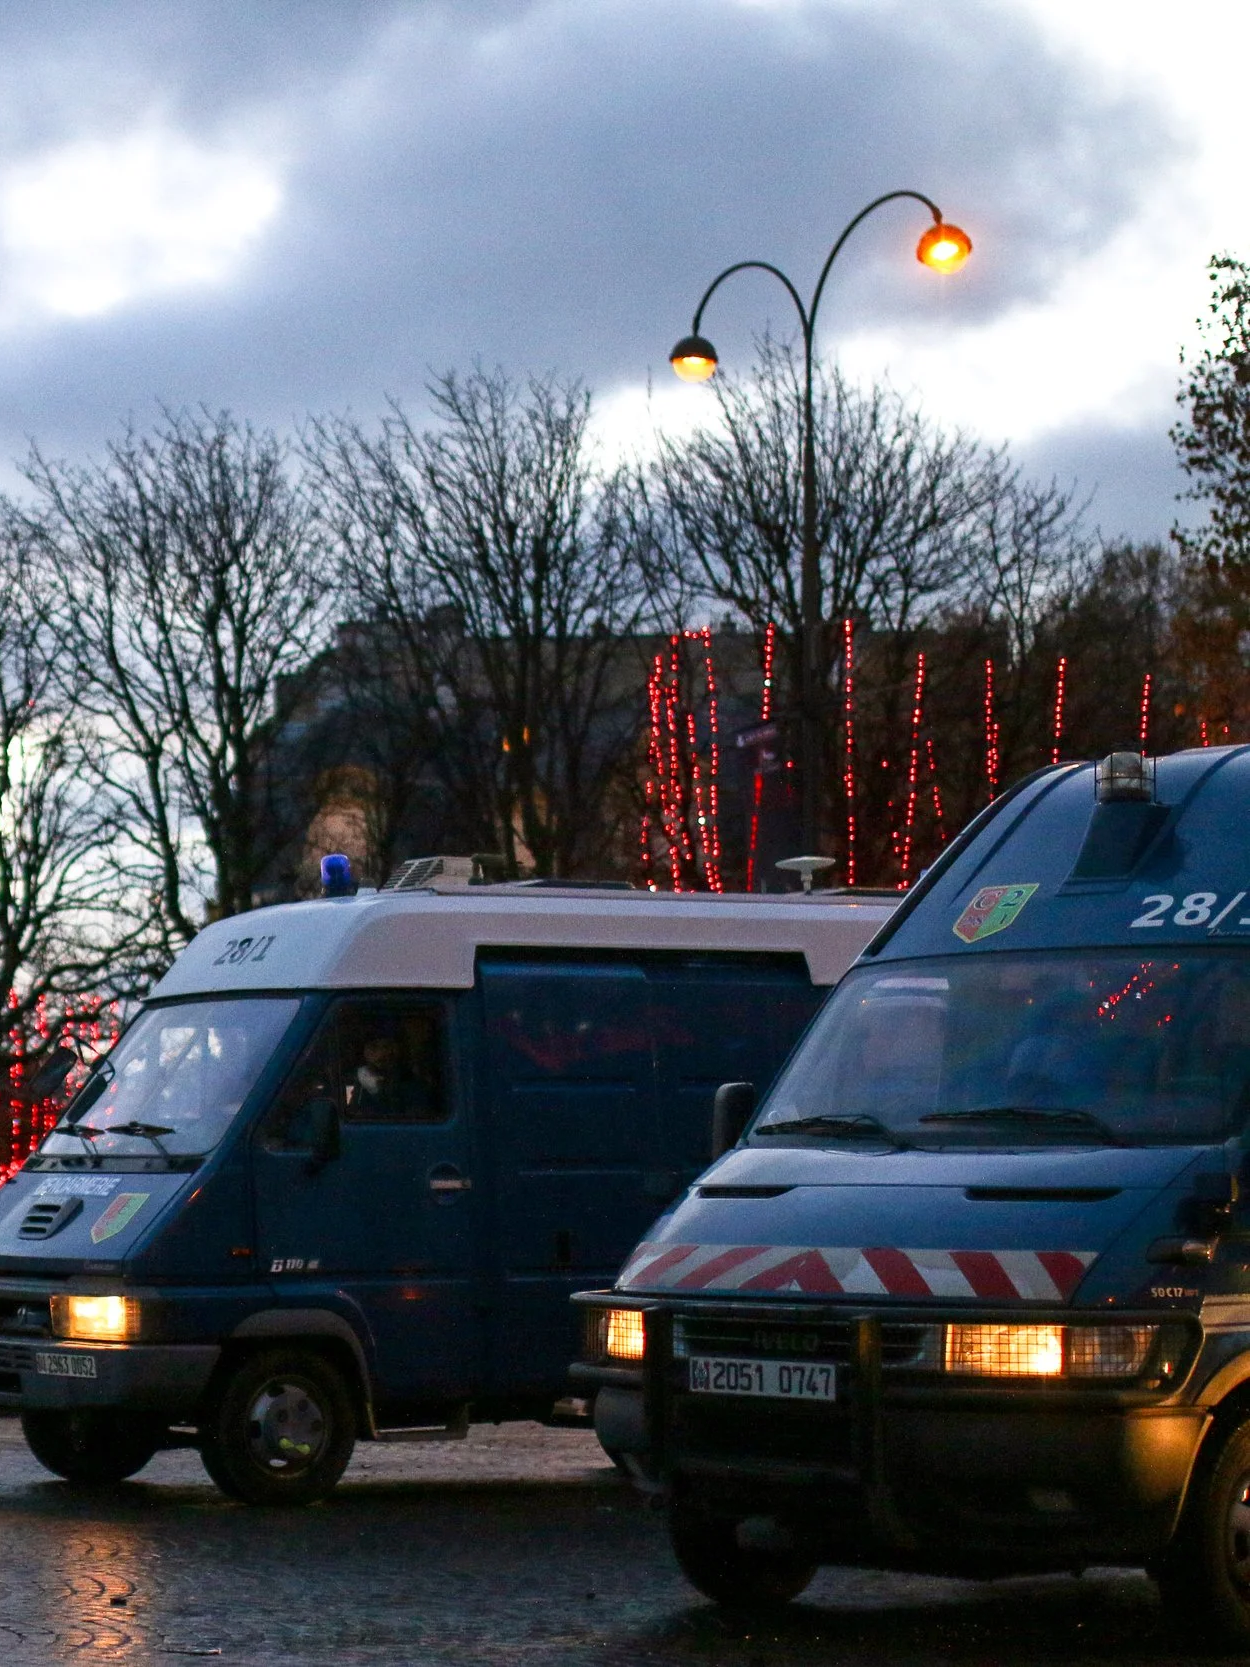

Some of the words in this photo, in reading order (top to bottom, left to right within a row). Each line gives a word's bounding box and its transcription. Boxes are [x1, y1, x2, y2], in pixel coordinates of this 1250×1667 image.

[1129, 892, 1250, 929] 28/
[212, 935, 277, 966] 28/1
[712, 1361, 764, 1392] 2051
[778, 1365, 831, 1397] 0747
